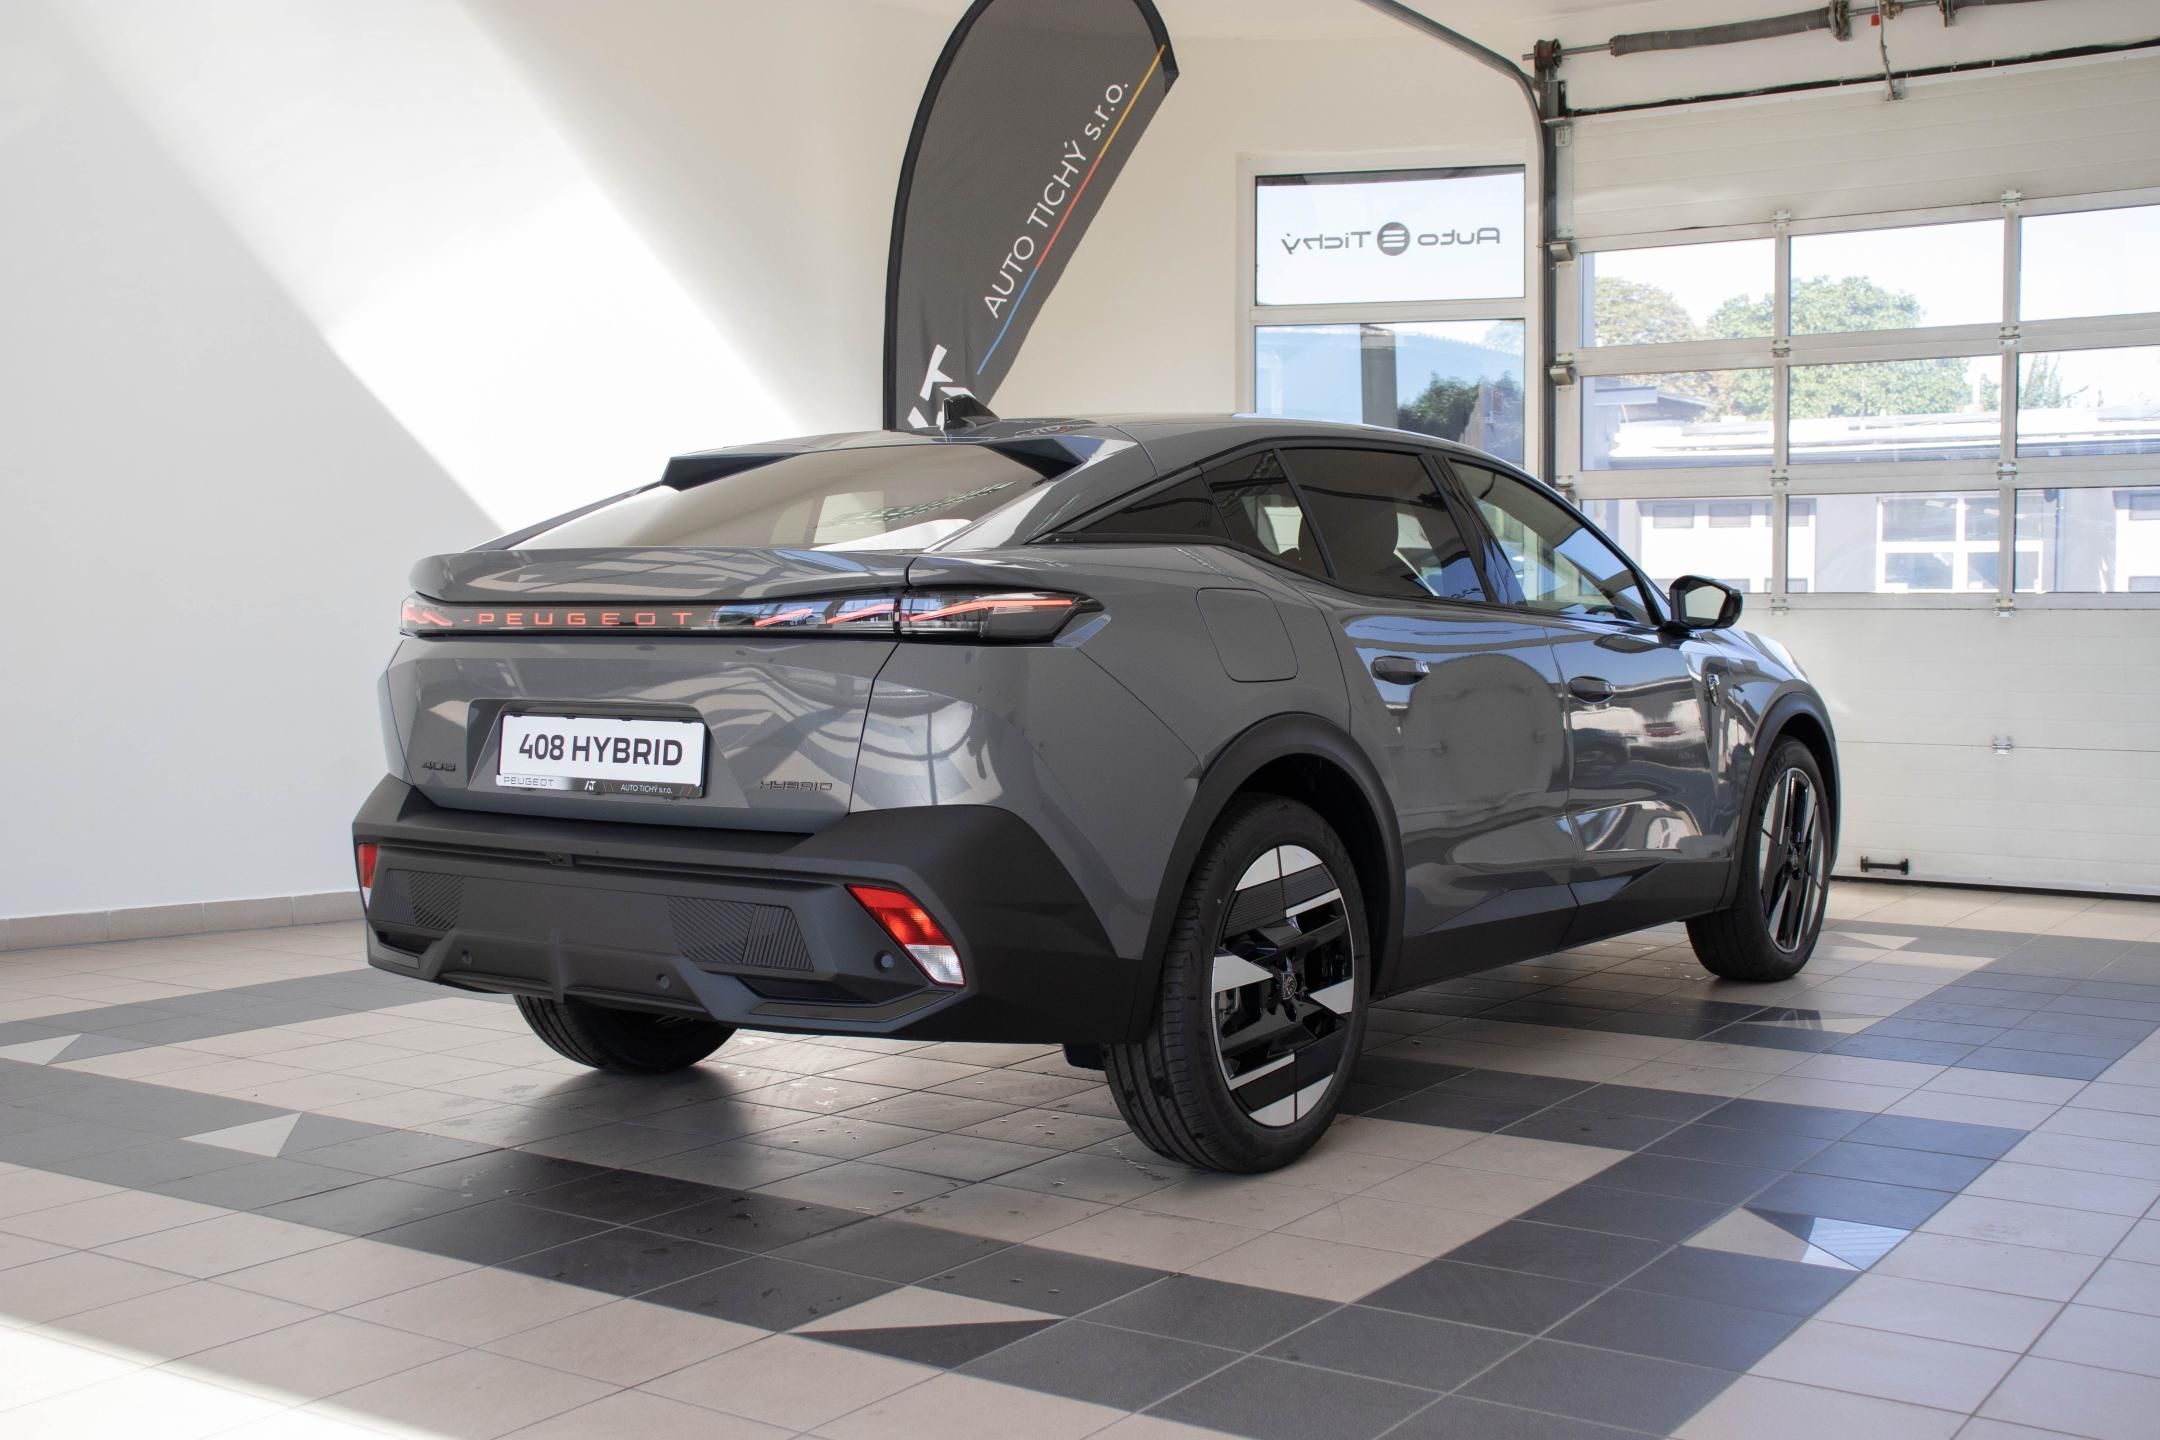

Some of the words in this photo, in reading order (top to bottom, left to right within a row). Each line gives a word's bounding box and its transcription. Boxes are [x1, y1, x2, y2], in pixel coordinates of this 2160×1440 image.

[984, 235, 1035, 318] AUTO
[1027, 139, 1087, 229] TICHÝ
[1084, 81, 1128, 141] s.r.o.
[477, 612, 693, 626] PEUGEOT
[519, 733, 565, 761] 408
[571, 735, 683, 767] HYBRID
[503, 776, 555, 787] PEUGEOT
[620, 783, 638, 792] AUTO
[639, 783, 658, 793] TICHÝ
[760, 780, 833, 792] HYBRID
